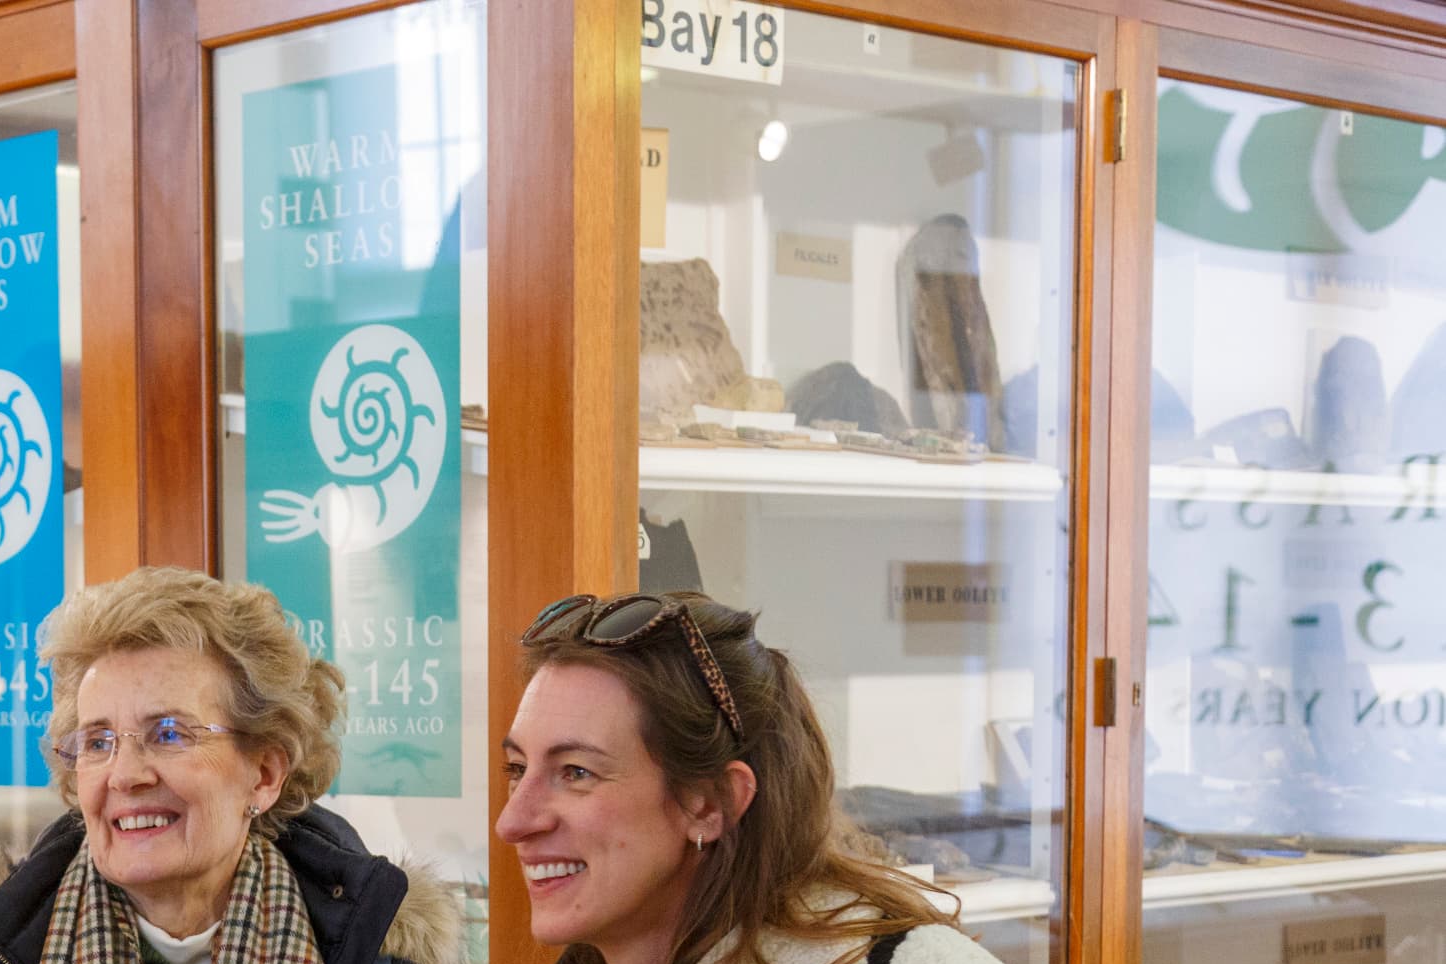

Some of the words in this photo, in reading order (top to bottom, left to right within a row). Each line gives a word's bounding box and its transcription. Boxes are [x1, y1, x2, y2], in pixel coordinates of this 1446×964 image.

[641, 0, 722, 66] Bay
[732, 10, 779, 67] 18
[259, 174, 402, 231] SHALLO
[304, 221, 395, 269] SEAS
[297, 614, 444, 649] RASSIC
[406, 716, 444, 735] AGO
